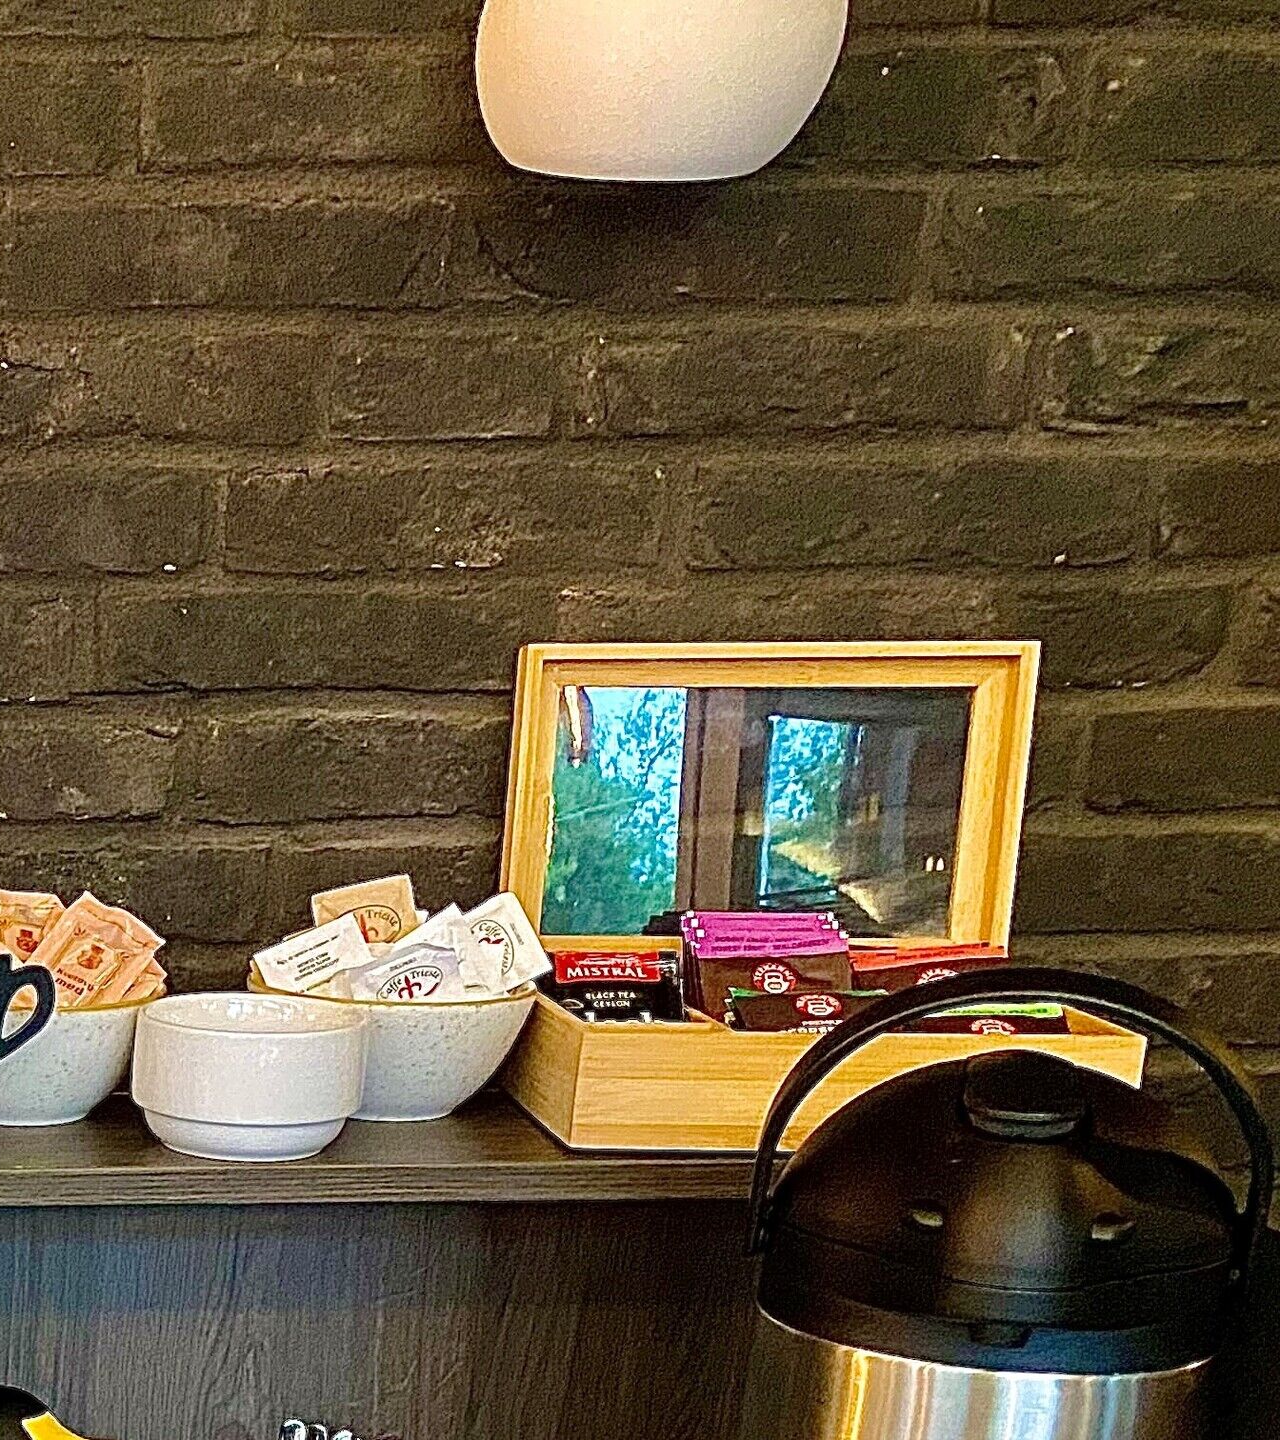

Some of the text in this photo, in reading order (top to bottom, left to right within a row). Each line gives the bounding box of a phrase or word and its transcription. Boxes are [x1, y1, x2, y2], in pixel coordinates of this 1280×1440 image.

[567, 967, 648, 978] MISTRAL
[55, 978, 85, 995] med
[585, 991, 637, 1000] BLACK TEA
